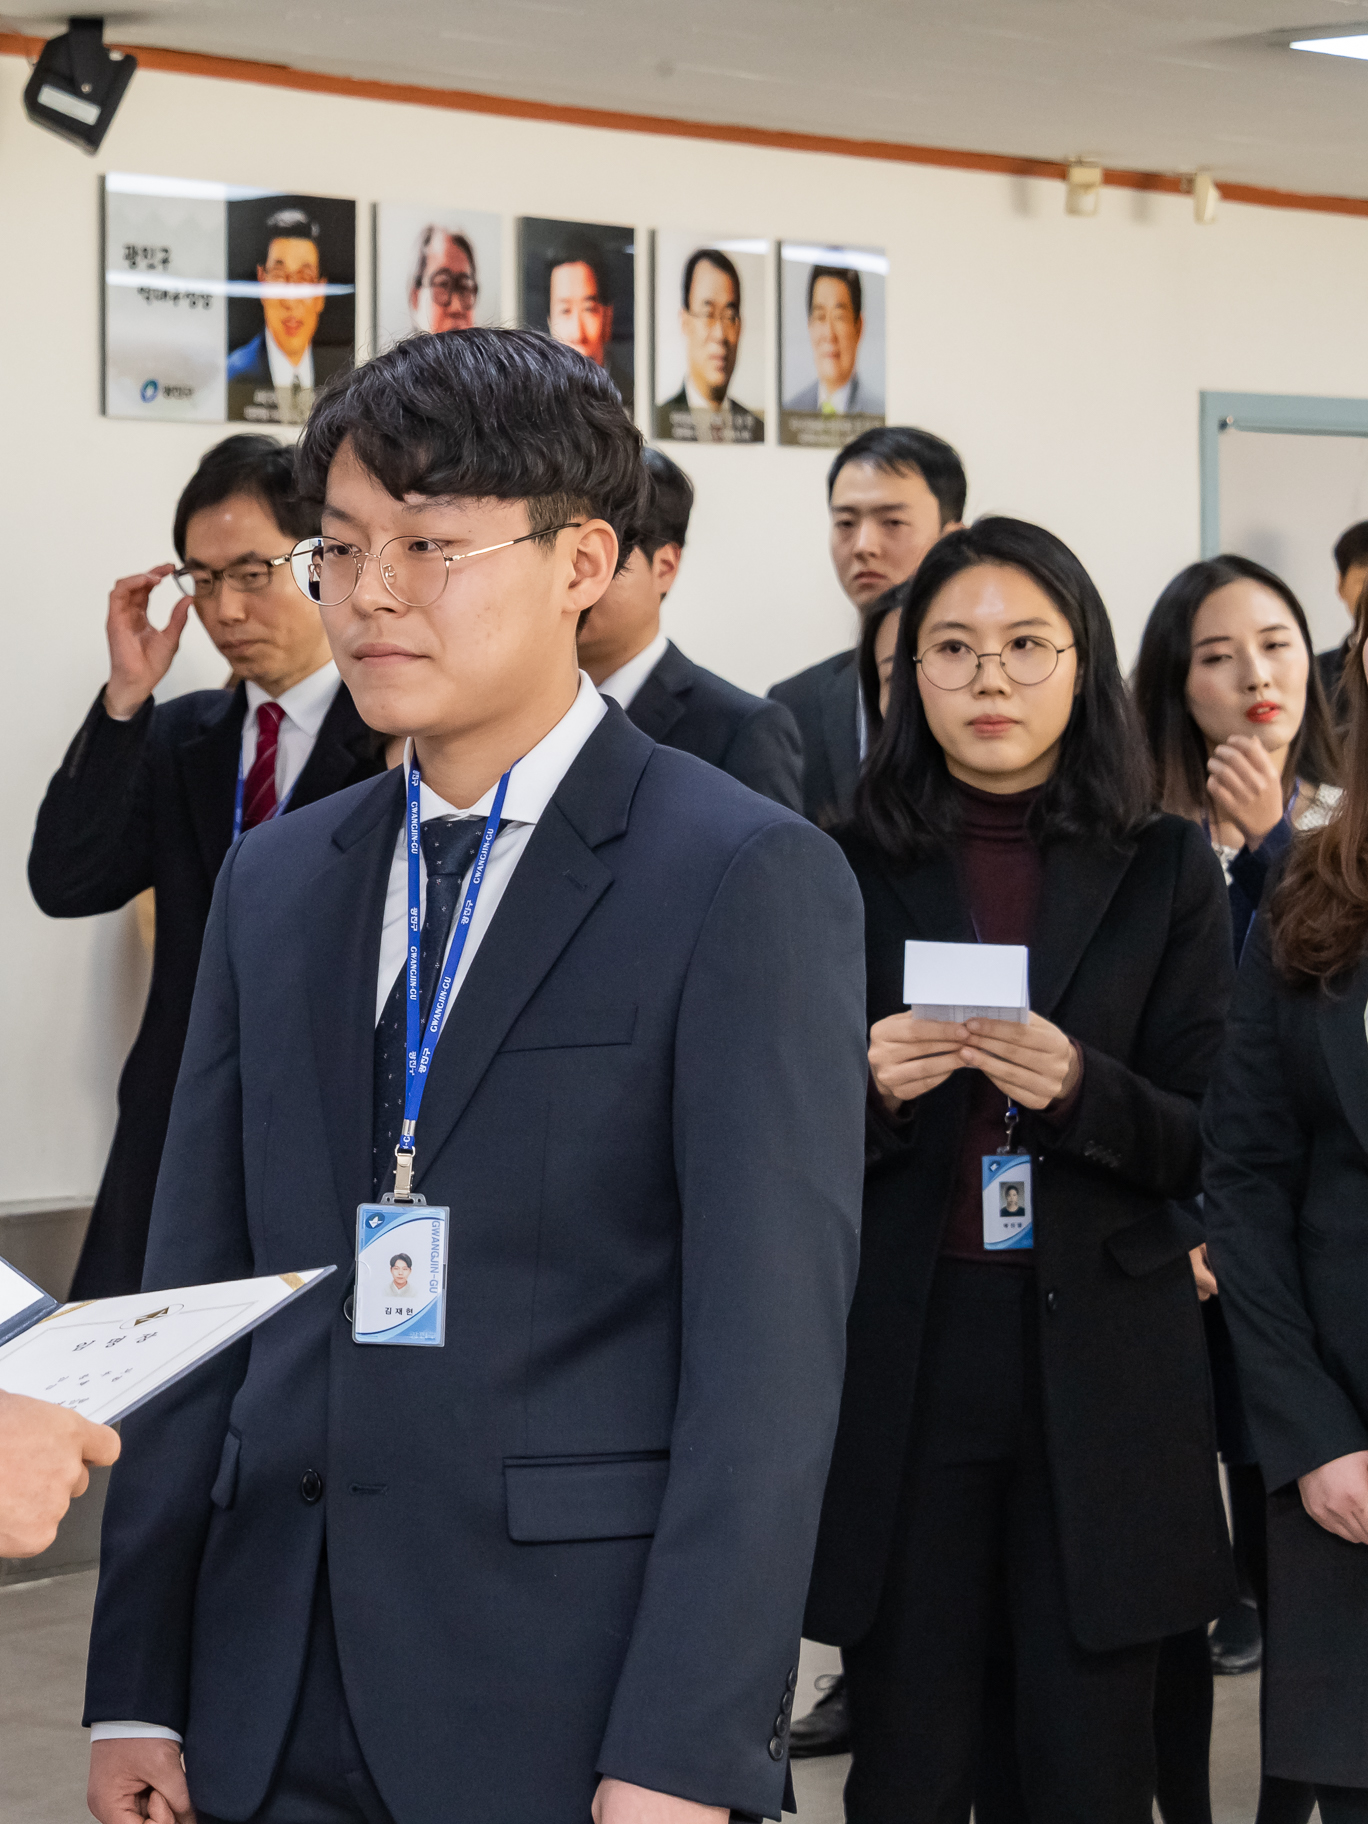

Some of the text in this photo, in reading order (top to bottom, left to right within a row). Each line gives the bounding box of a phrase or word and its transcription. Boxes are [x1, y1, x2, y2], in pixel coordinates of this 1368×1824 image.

[123, 245, 170, 270] 광진구
[410, 801, 418, 855] GWANGJIN-GU
[461, 828, 494, 925] 광진구 GWANGJIN-GU
[410, 906, 418, 1001] 광진구 GWANGJIN-GU
[417, 976, 452, 1074] 광진구 GWANGJIN-GU
[429, 1220, 441, 1294] GWANGJIN-GU
